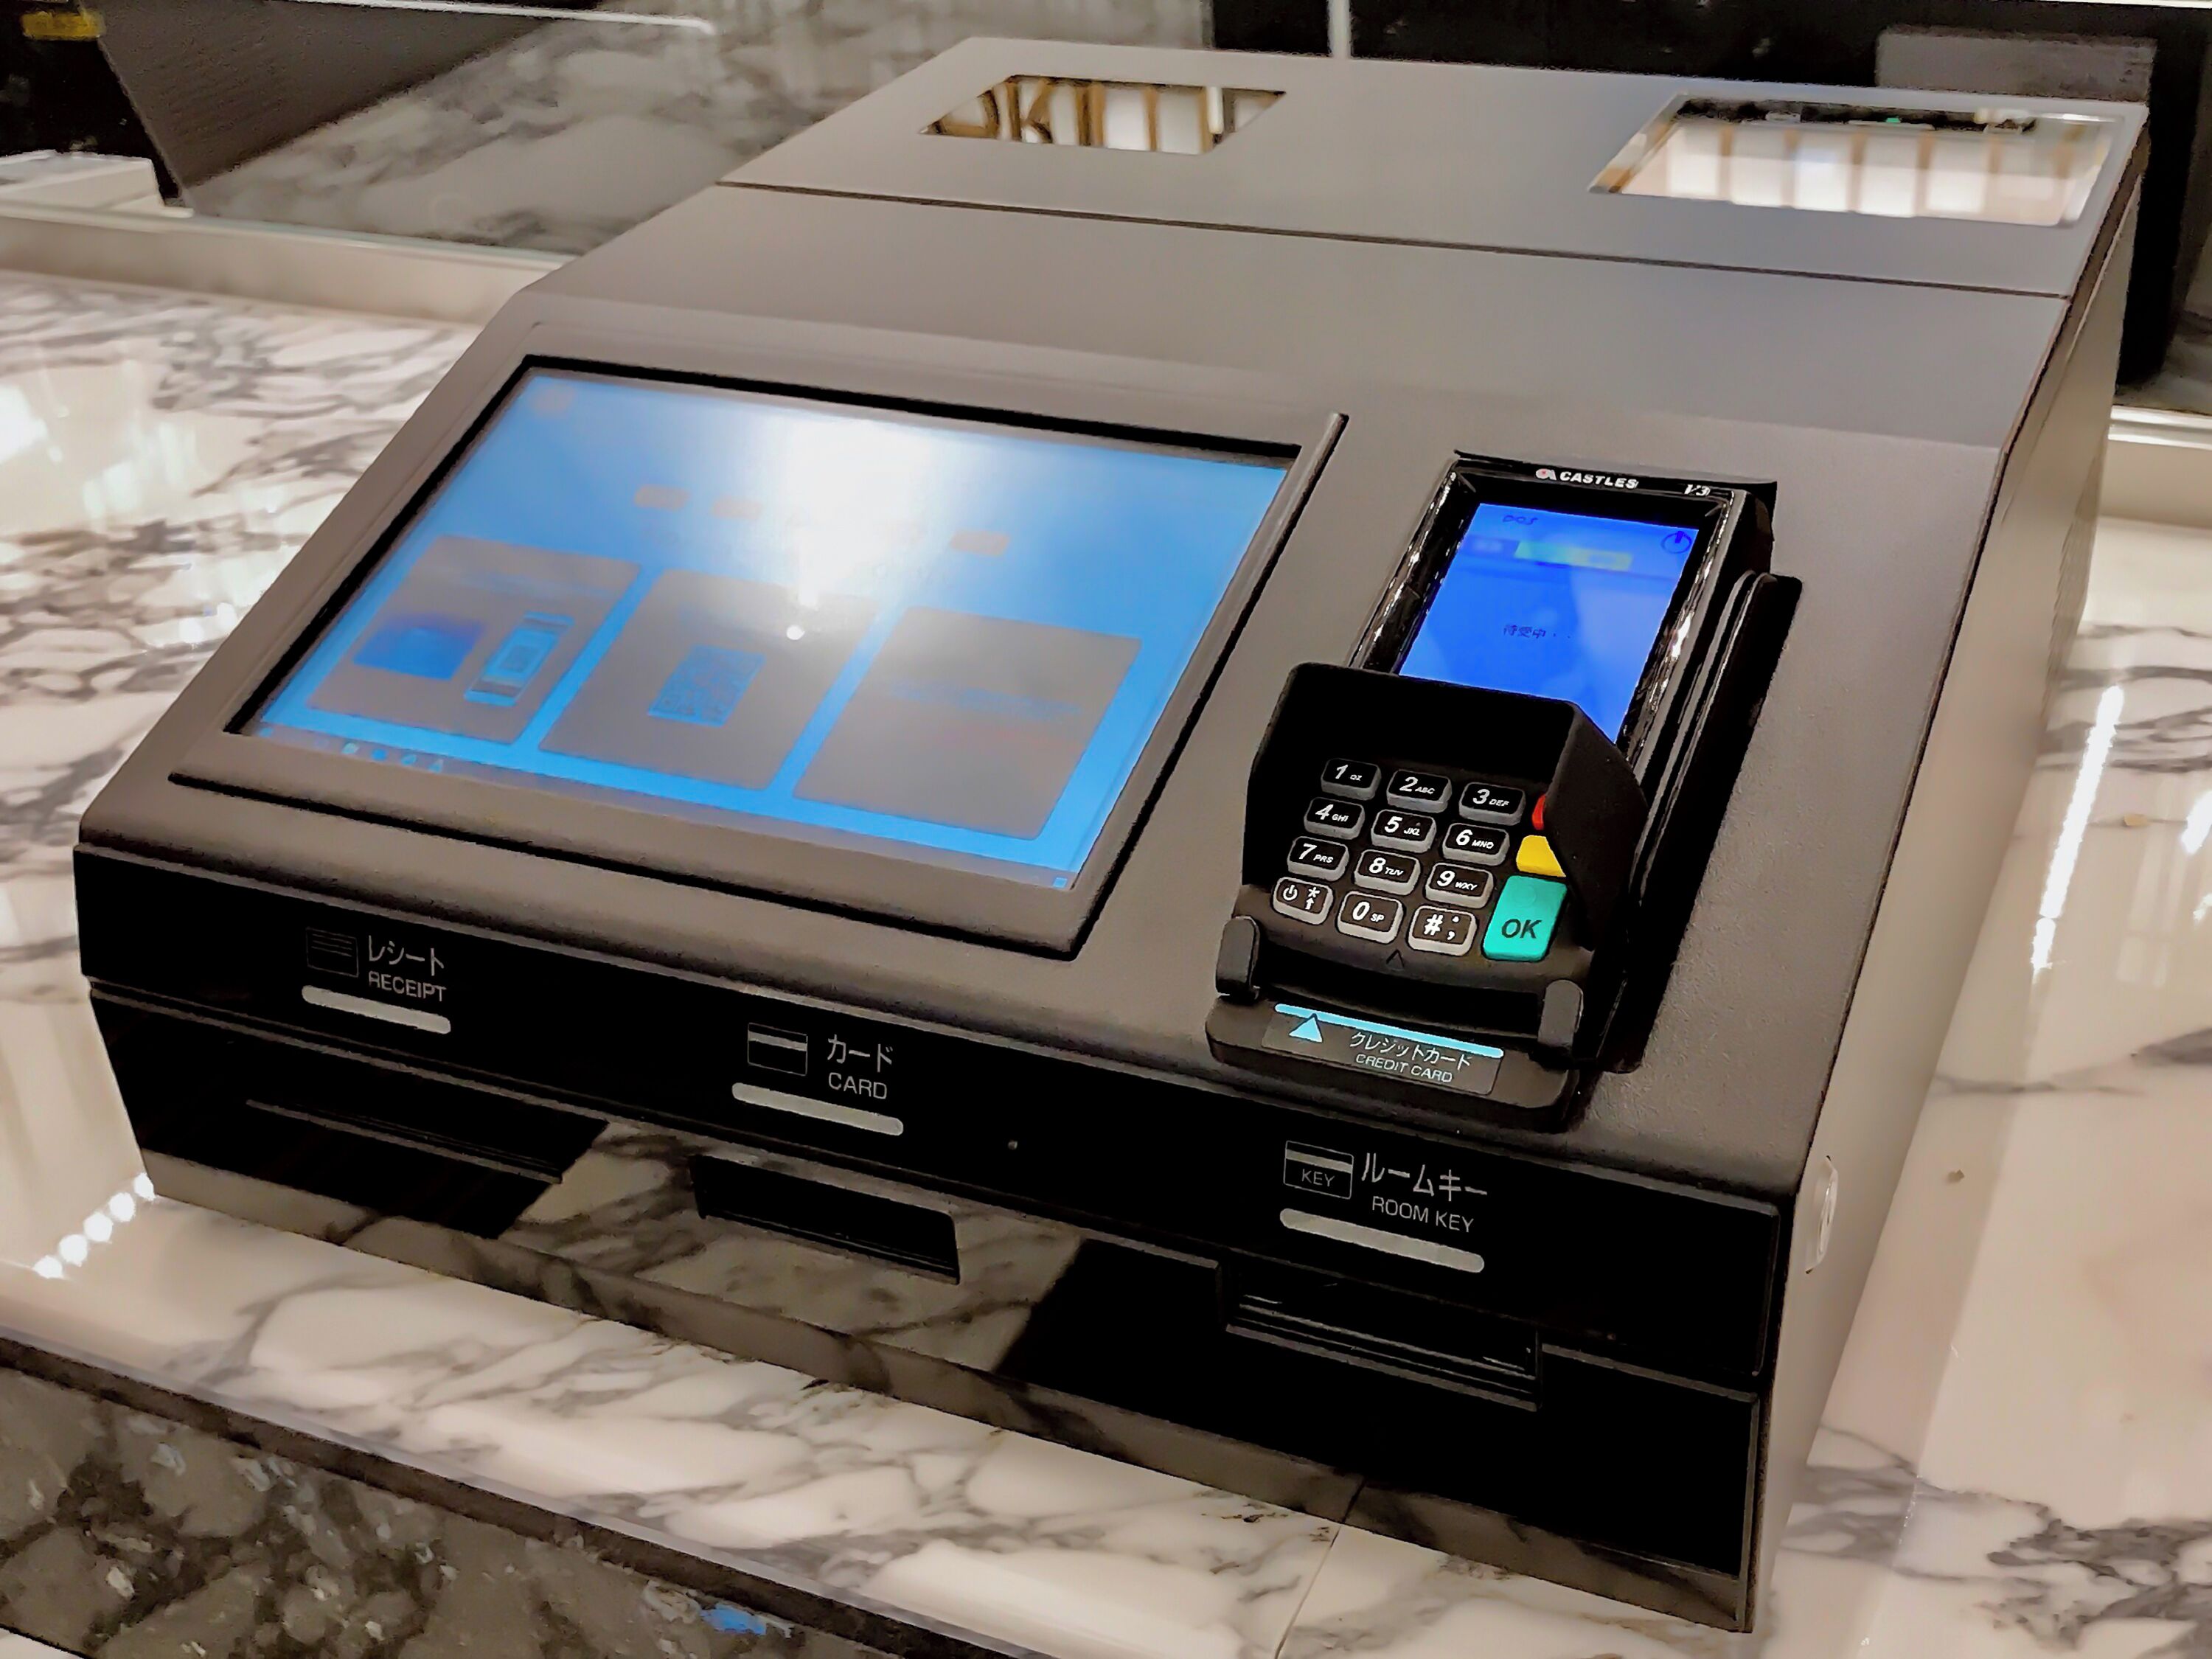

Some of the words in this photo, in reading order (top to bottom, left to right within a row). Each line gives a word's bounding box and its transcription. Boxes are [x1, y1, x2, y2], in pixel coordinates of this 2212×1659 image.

[1560, 472, 1638, 488] CASTLES
[1336, 765, 1348, 779] 1
[1399, 777, 1419, 792] 2
[1416, 787, 1435, 795] ABC
[1473, 789, 1489, 804] 3
[1315, 804, 1333, 819] 4
[1385, 816, 1403, 832] 5
[1456, 830, 1472, 845] 6
[1472, 840, 1494, 849] MNO
[1299, 844, 1317, 859] 7
[1314, 854, 1333, 863] PRS
[1369, 858, 1386, 874] 8
[1385, 867, 1403, 875] TUV
[1437, 871, 1456, 886] 9
[1455, 882, 1477, 890] WXY
[1353, 902, 1370, 920] 0
[1371, 914, 1384, 922] SP
[1425, 914, 1443, 935] #
[1502, 919, 1542, 938] OK
[369, 935, 445, 976] レシート
[369, 970, 447, 1002] RECEIPT
[827, 1034, 894, 1073] カード
[1350, 1032, 1472, 1071] クレジットカード
[1356, 1053, 1409, 1072] CREDIT
[1411, 1065, 1453, 1082] CARD
[828, 1072, 887, 1099] CARD
[1301, 1168, 1335, 1187] KEY
[1361, 1152, 1488, 1202] ルームキー
[1373, 1196, 1428, 1222] ROOM
[1436, 1211, 1474, 1233] KEY
